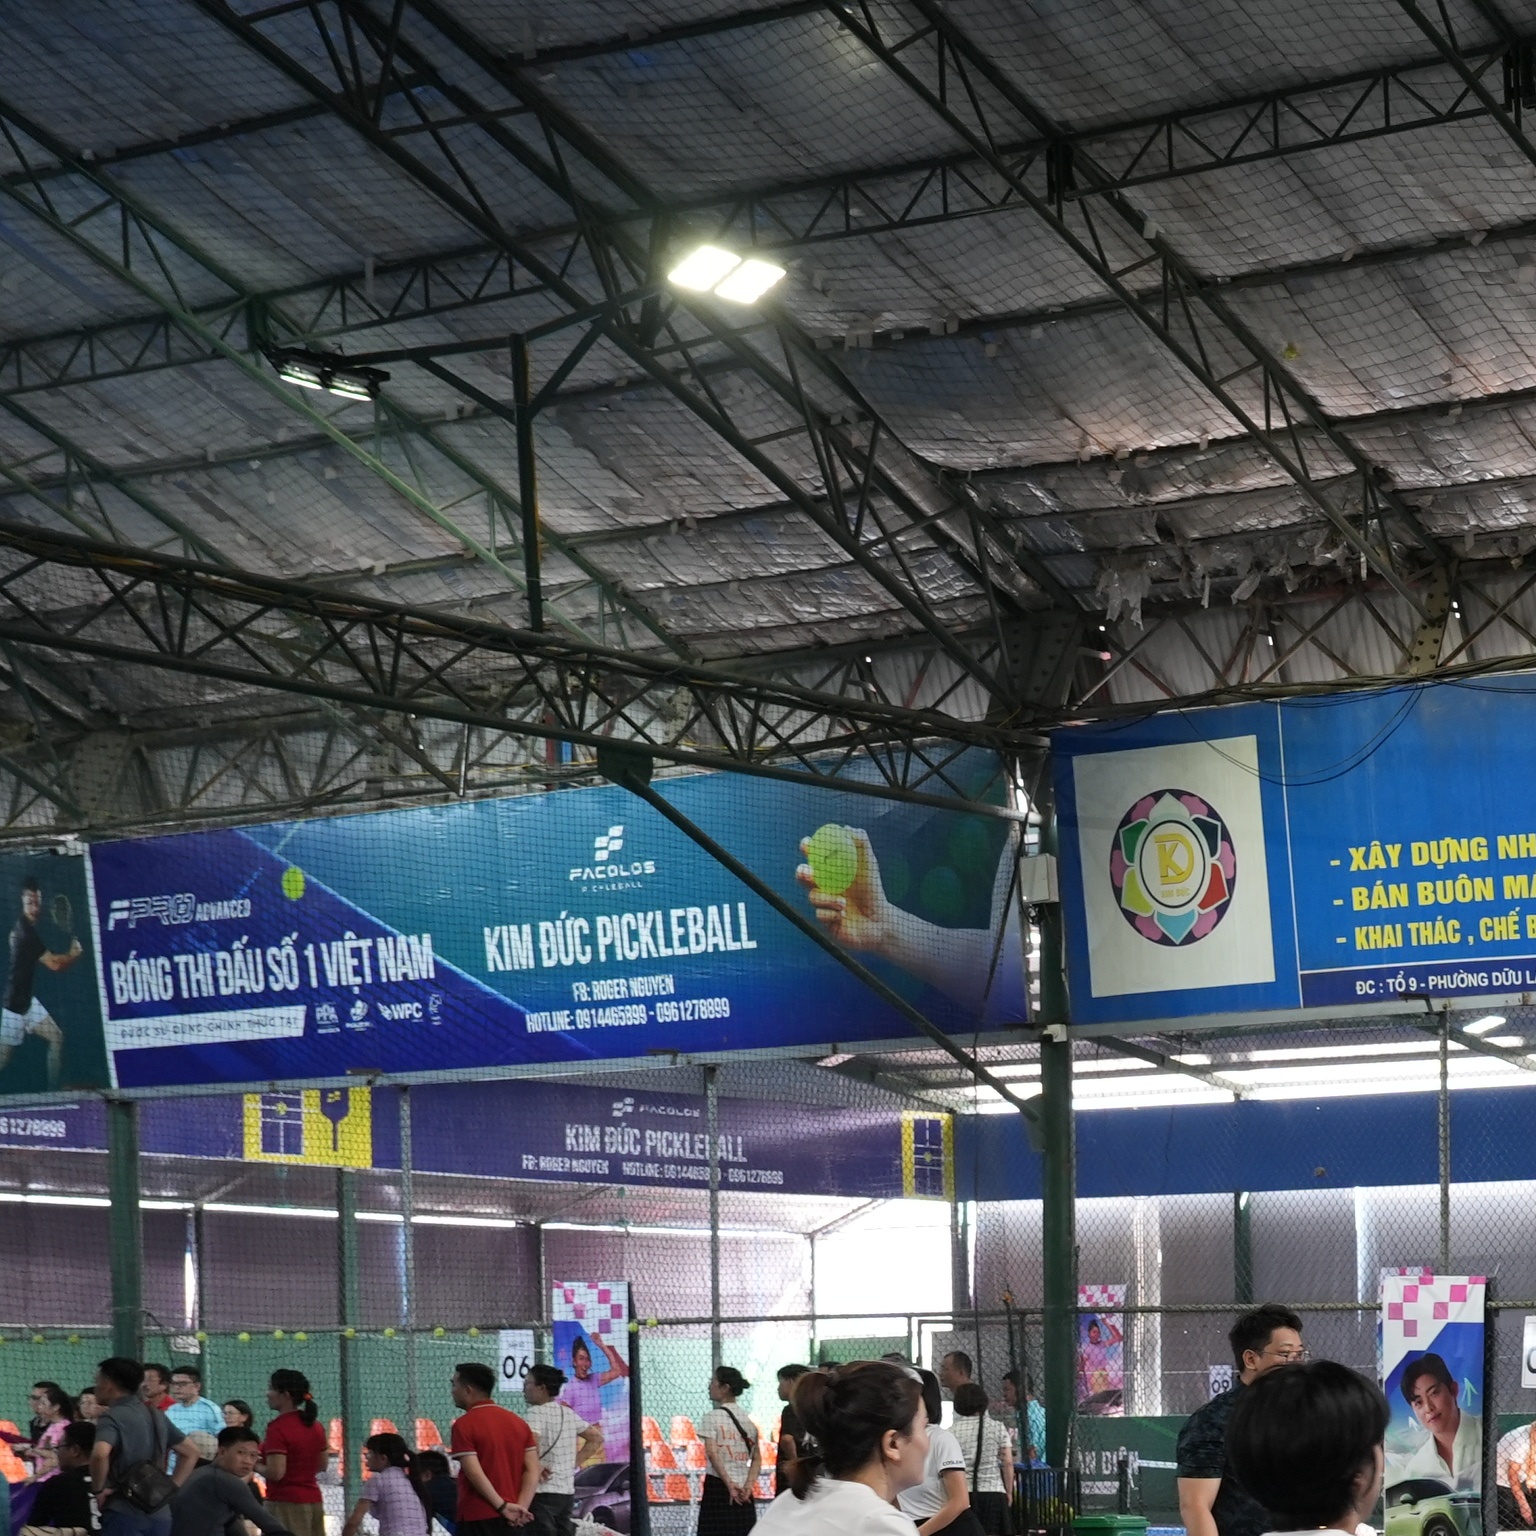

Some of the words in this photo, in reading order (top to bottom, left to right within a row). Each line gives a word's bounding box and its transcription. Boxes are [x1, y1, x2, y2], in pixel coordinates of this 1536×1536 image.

[1348, 840, 1402, 871] XÂY
[1411, 837, 1488, 869] DỰNG
[569, 861, 655, 880] FACOLOS
[484, 924, 534, 972] KIM
[539, 910, 592, 968] ĐỨC
[596, 902, 757, 962] PICKLEBALL
[111, 951, 173, 1004] BÓNG
[174, 952, 214, 999] THI
[215, 936, 264, 996] ĐẤU
[267, 932, 298, 991] SỐ
[304, 943, 318, 988] 1
[319, 931, 372, 994] VIỆT
[377, 933, 435, 982] NAM
[1386, 972, 1405, 992] TỔ
[1409, 978, 1416, 991] 9
[1428, 972, 1488, 990] PHƯỜNG
[1492, 968, 1520, 987] DỮU
[592, 980, 628, 1000] ROGER
[630, 974, 674, 997] NGUYEN
[526, 1011, 575, 1033] HOTLINE:
